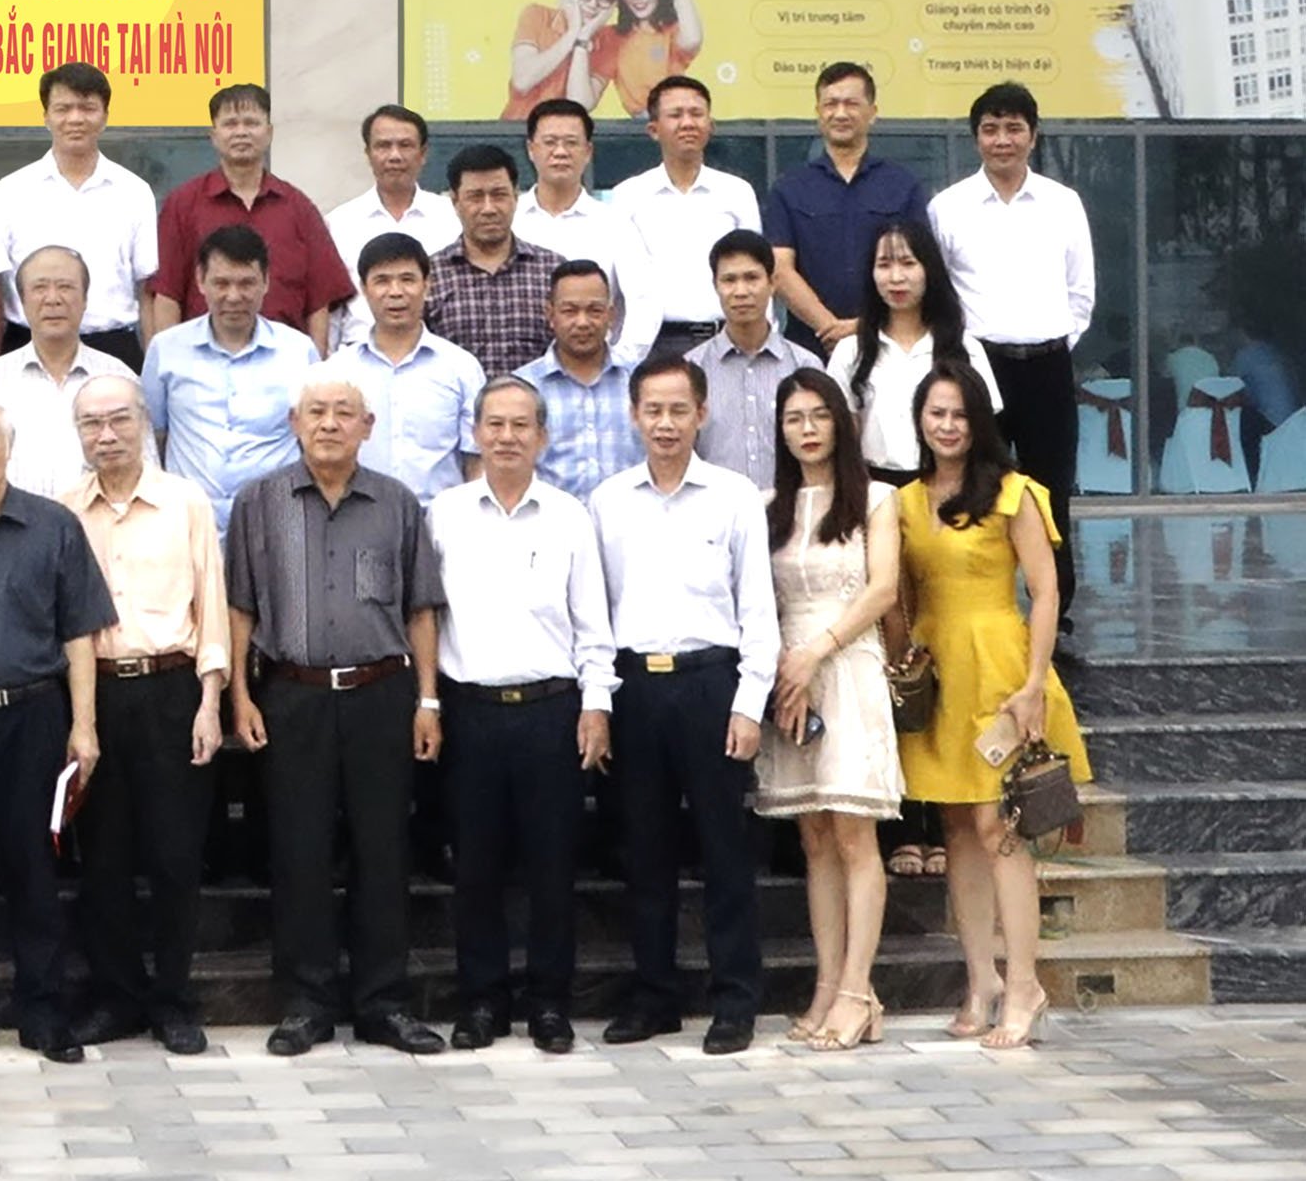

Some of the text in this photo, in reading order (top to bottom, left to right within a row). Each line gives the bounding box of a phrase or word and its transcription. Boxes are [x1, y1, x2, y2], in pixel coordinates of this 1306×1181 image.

[42, 22, 109, 75] GIANG
[117, 22, 151, 86] TẠI
[159, 12, 187, 74] HÀ
[195, 11, 233, 86] NỘI
